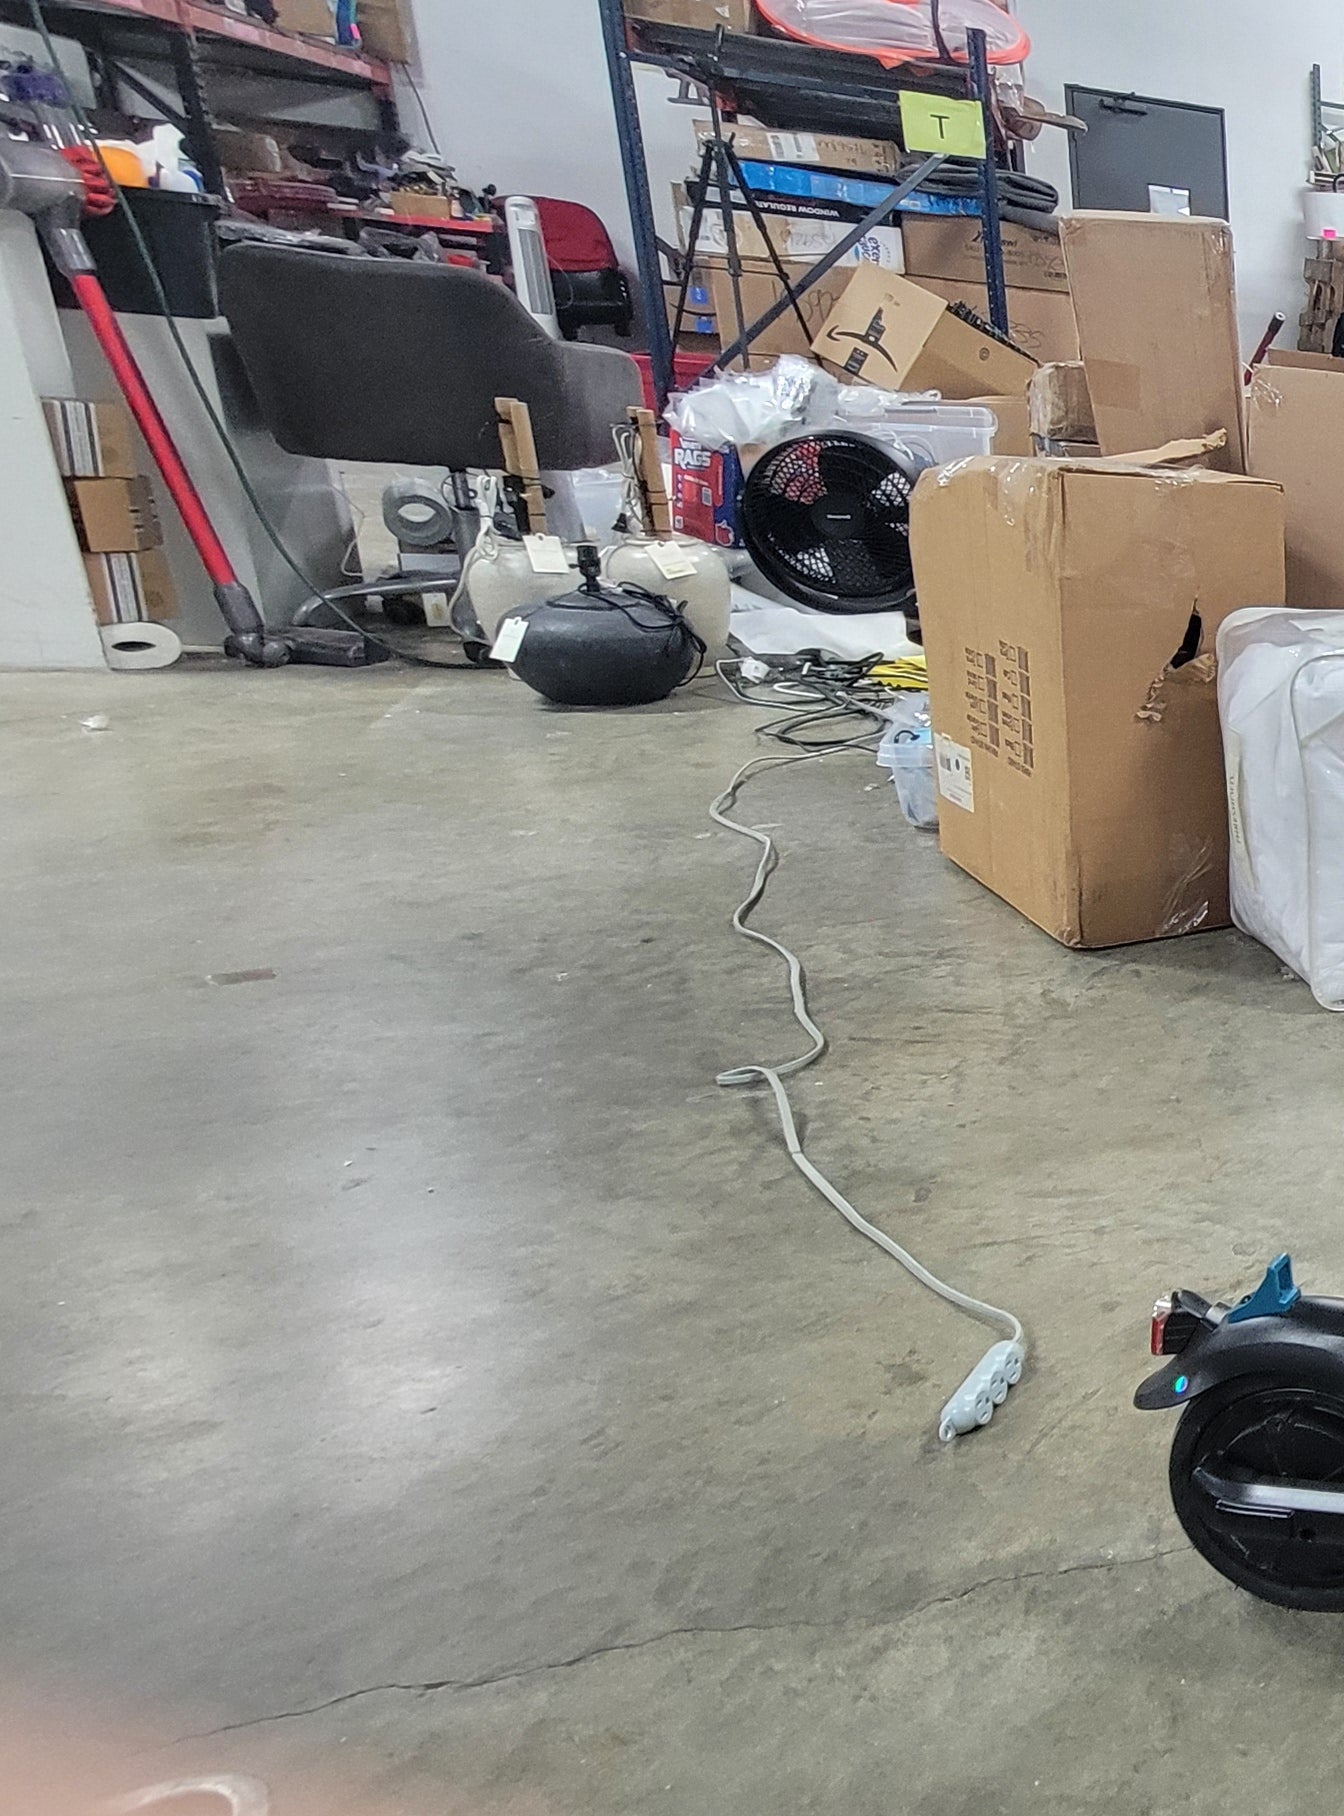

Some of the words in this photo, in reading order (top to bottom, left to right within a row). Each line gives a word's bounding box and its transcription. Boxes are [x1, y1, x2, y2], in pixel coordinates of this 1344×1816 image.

[930, 113, 950, 140] T
[799, 205, 840, 217] WINDOW
[673, 448, 712, 470] RAGS
